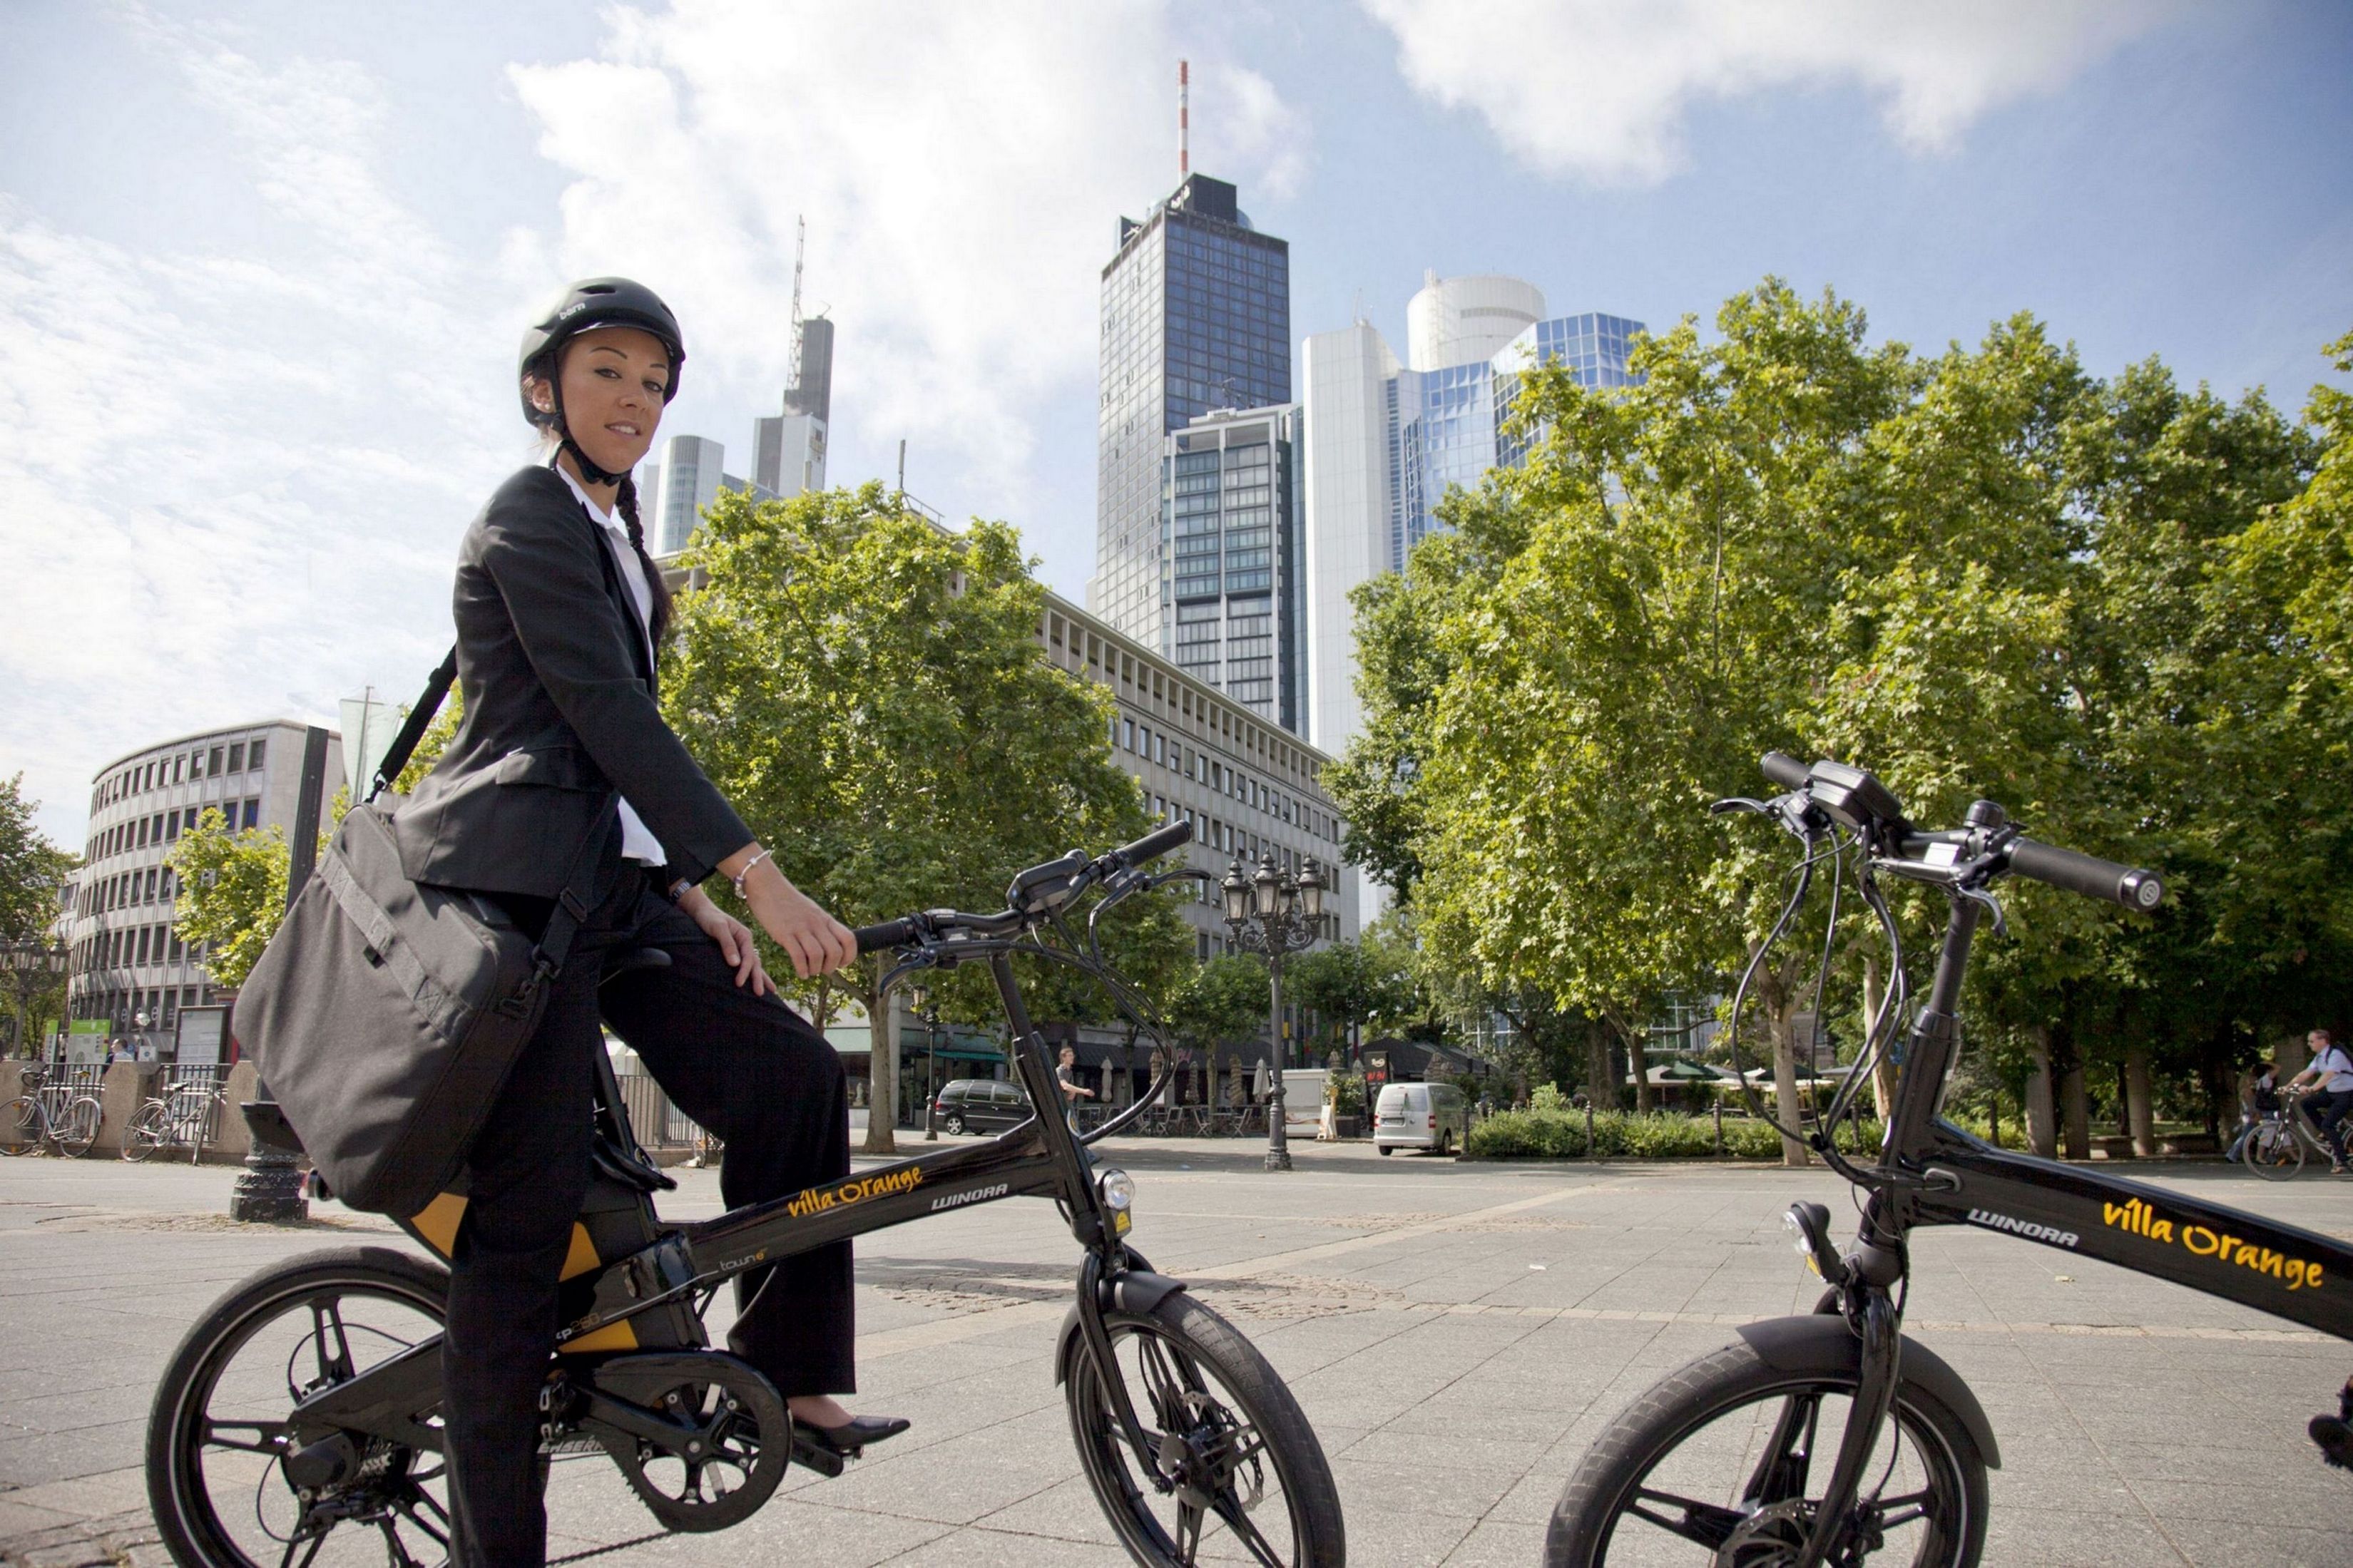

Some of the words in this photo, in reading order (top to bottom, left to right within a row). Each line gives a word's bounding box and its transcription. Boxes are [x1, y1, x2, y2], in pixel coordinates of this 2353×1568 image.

[839, 1167, 923, 1203] Orange
[931, 1183, 1008, 1211] WINORA
[1967, 1208, 2079, 1247] WINORA
[2182, 1225, 2324, 1291] Orange
